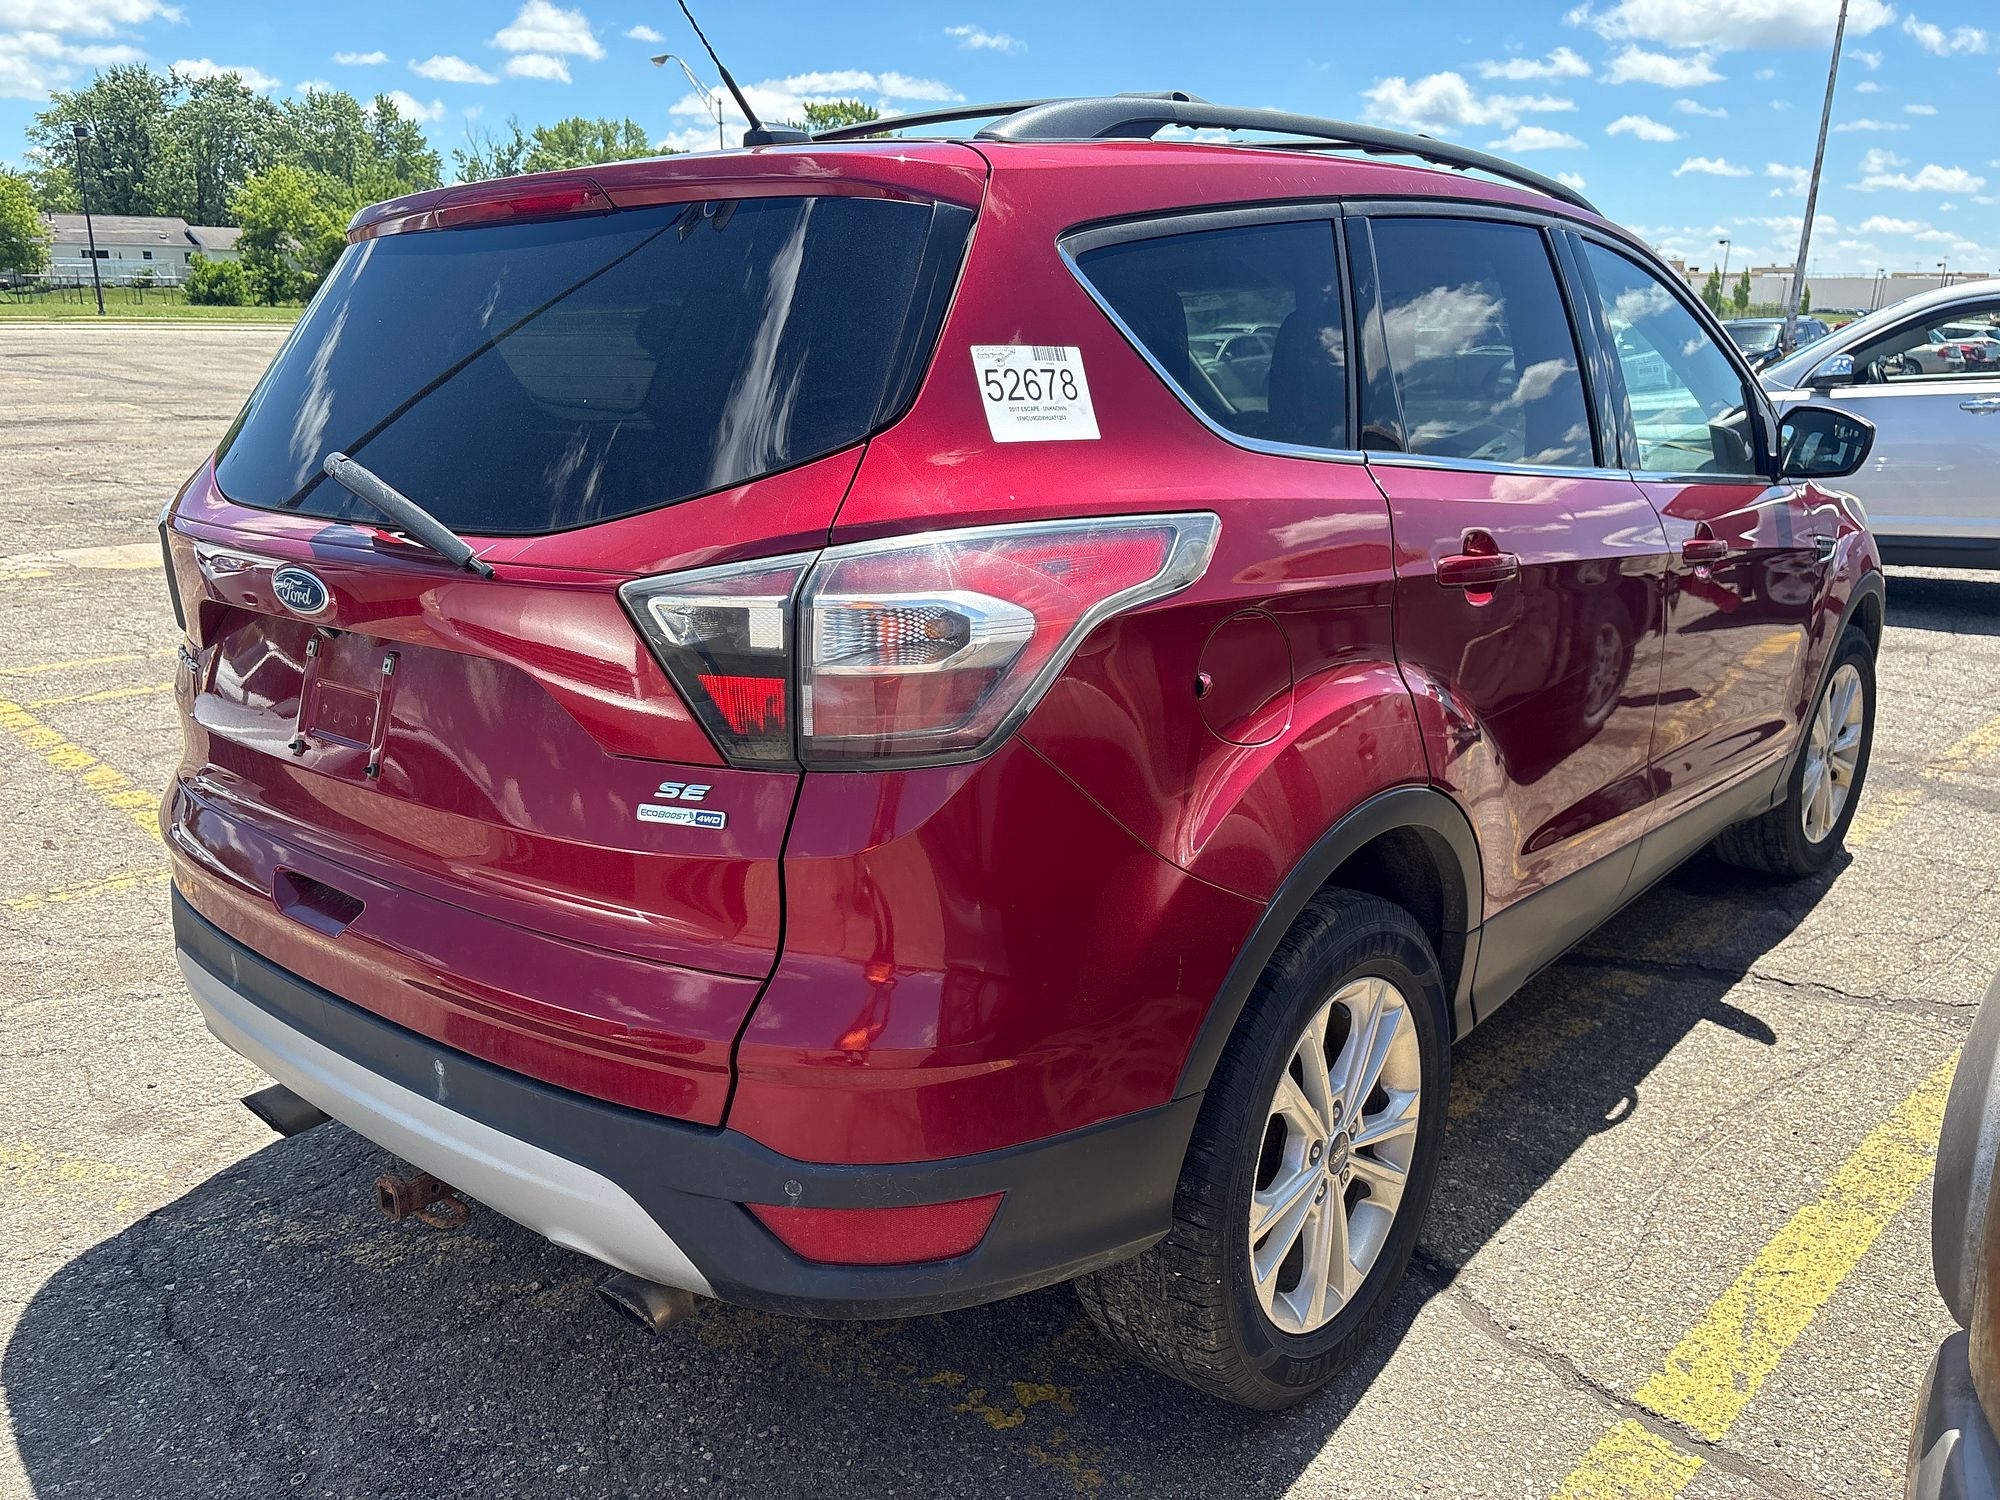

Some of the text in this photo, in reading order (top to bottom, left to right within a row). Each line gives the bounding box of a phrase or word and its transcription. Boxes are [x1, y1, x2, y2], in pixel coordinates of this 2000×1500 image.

[984, 368, 1078, 402] 52678
[274, 577, 312, 605] Ford
[653, 781, 712, 801] SE
[640, 809, 721, 824] ECOBOOST 4WD
